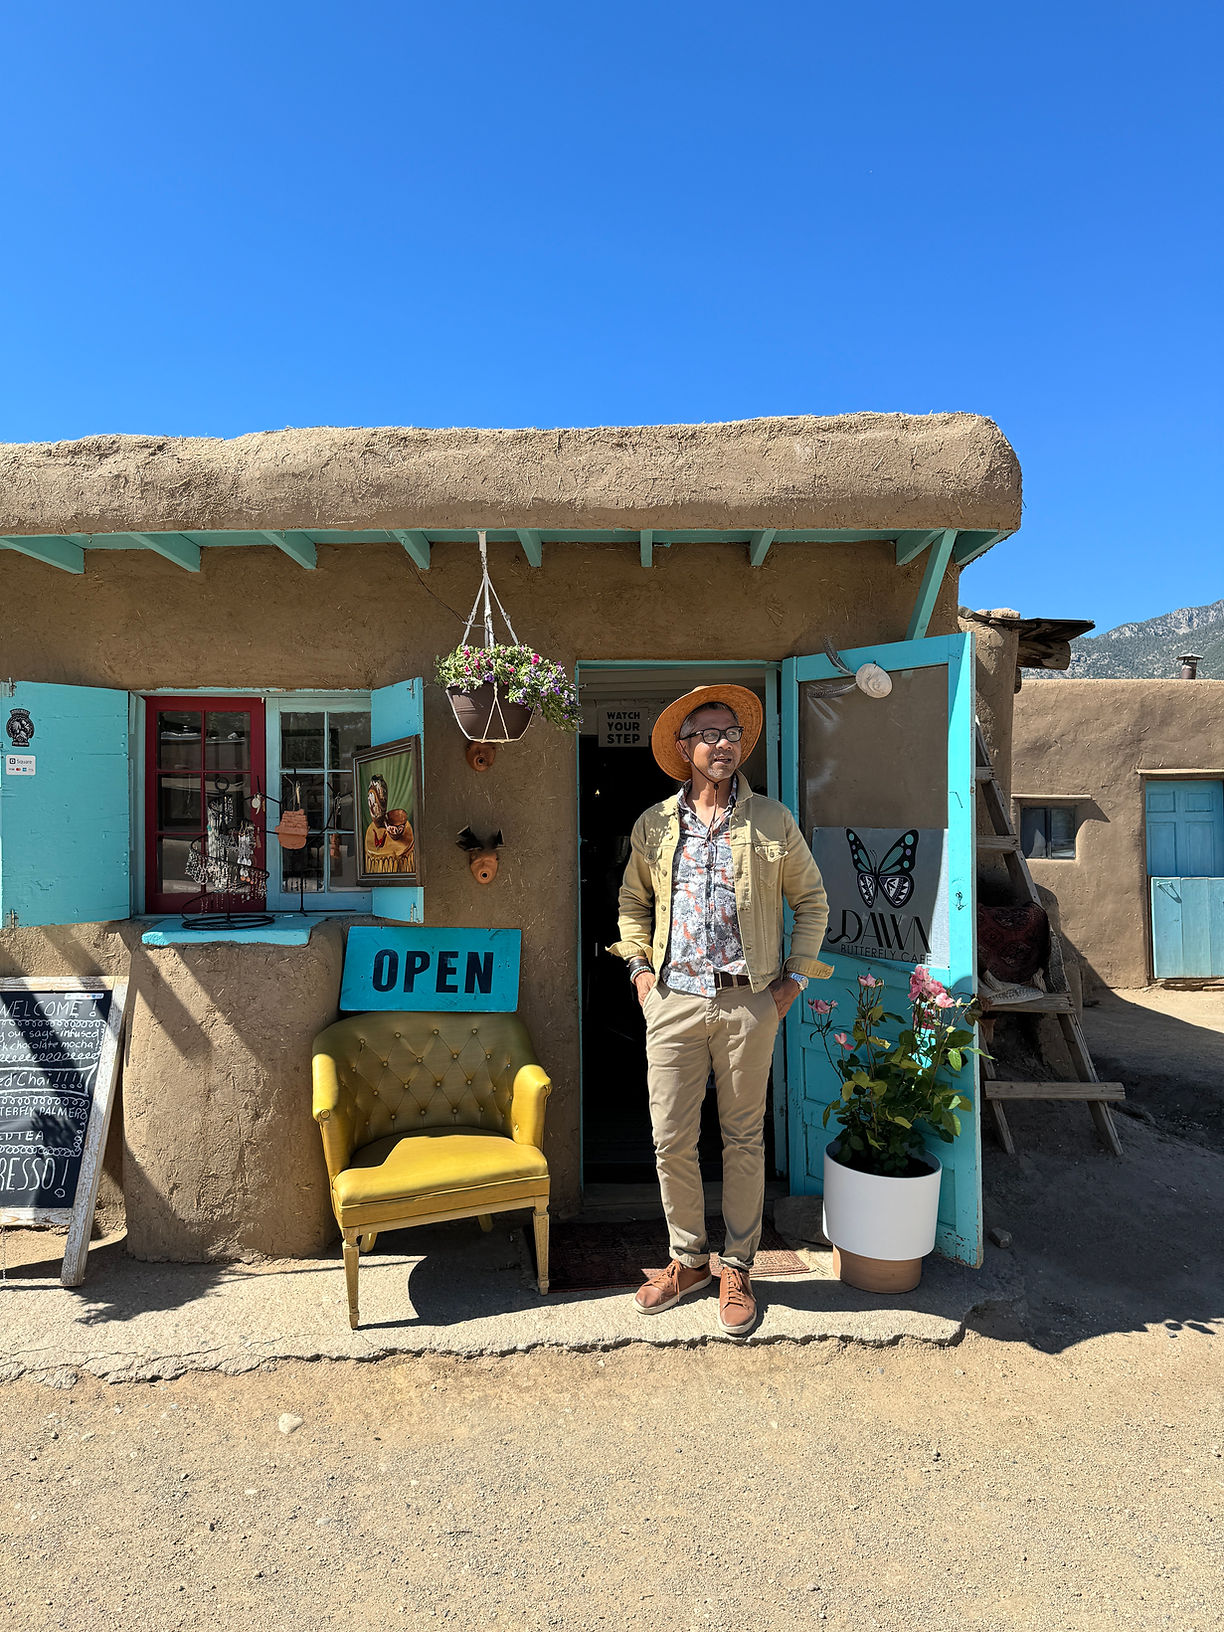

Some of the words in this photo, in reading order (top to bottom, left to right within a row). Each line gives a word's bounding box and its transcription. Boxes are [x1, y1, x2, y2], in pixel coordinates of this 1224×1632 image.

[607, 711, 640, 720] WATCH
[607, 722, 640, 731] YOUR
[607, 733, 640, 744] STEP
[827, 909, 931, 953] DAWN
[841, 944, 896, 960] BUTTERFLY
[372, 949, 494, 994] OPEN
[0, 1000, 82, 1017] WELCOME
[8, 1030, 25, 1038] our
[10, 1040, 58, 1051] chocolate
